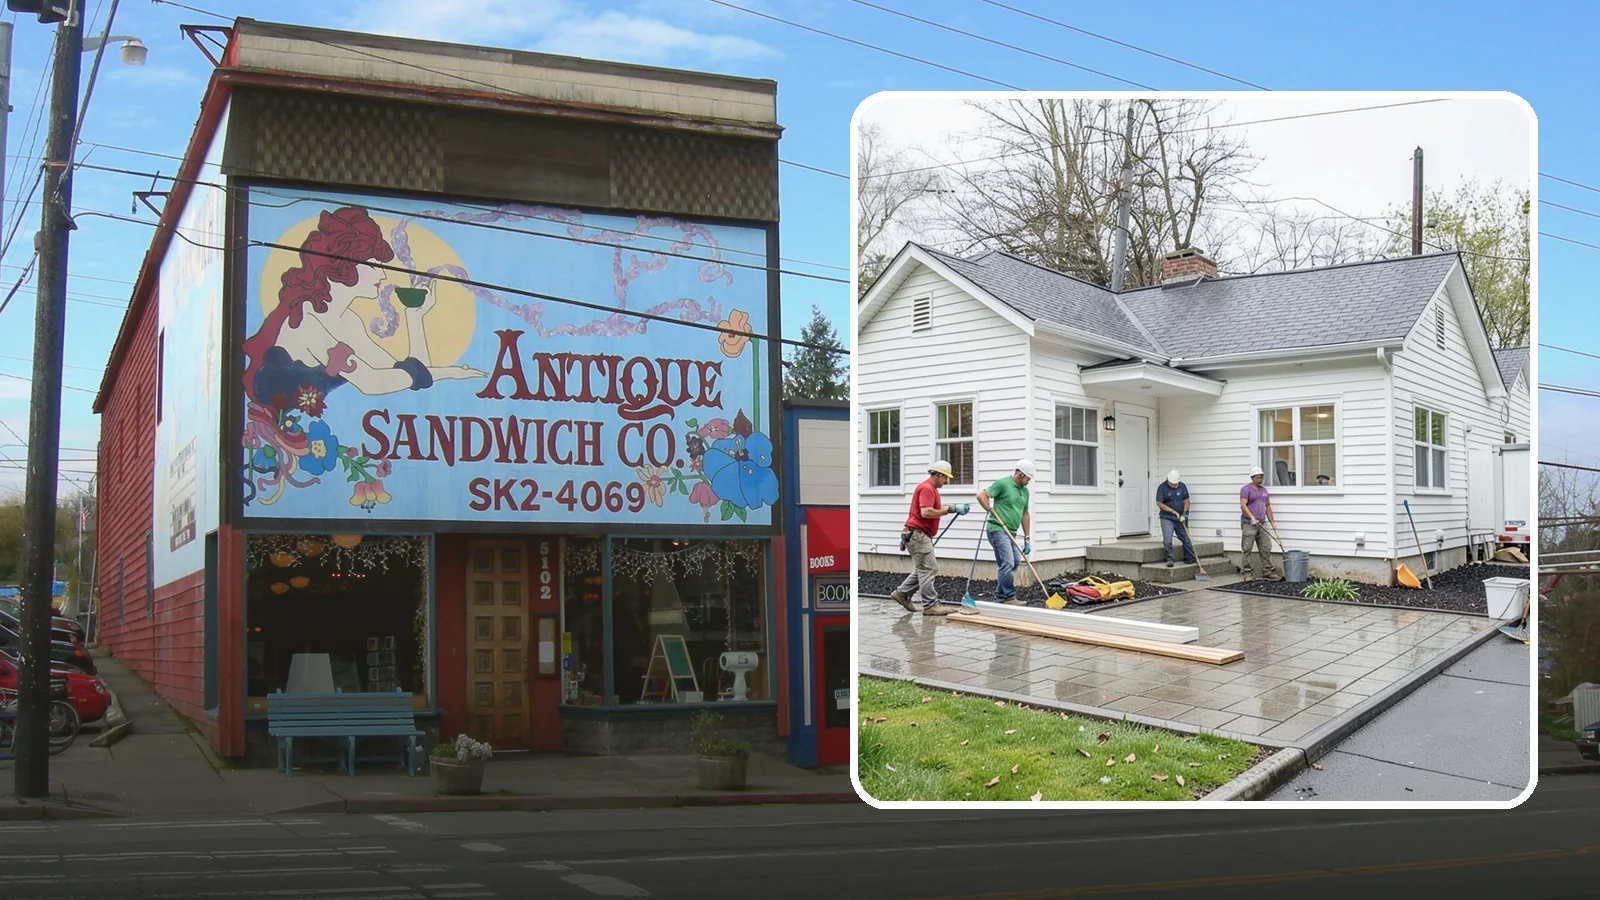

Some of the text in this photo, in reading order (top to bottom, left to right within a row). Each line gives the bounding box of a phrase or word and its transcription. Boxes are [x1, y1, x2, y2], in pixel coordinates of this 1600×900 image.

[475, 329, 724, 421] ANTIQUE
[361, 408, 685, 469] SANDWICH CO.
[468, 477, 646, 513] SK2-4069
[540, 542, 551, 599] 5102
[810, 555, 834, 568] BOOKS
